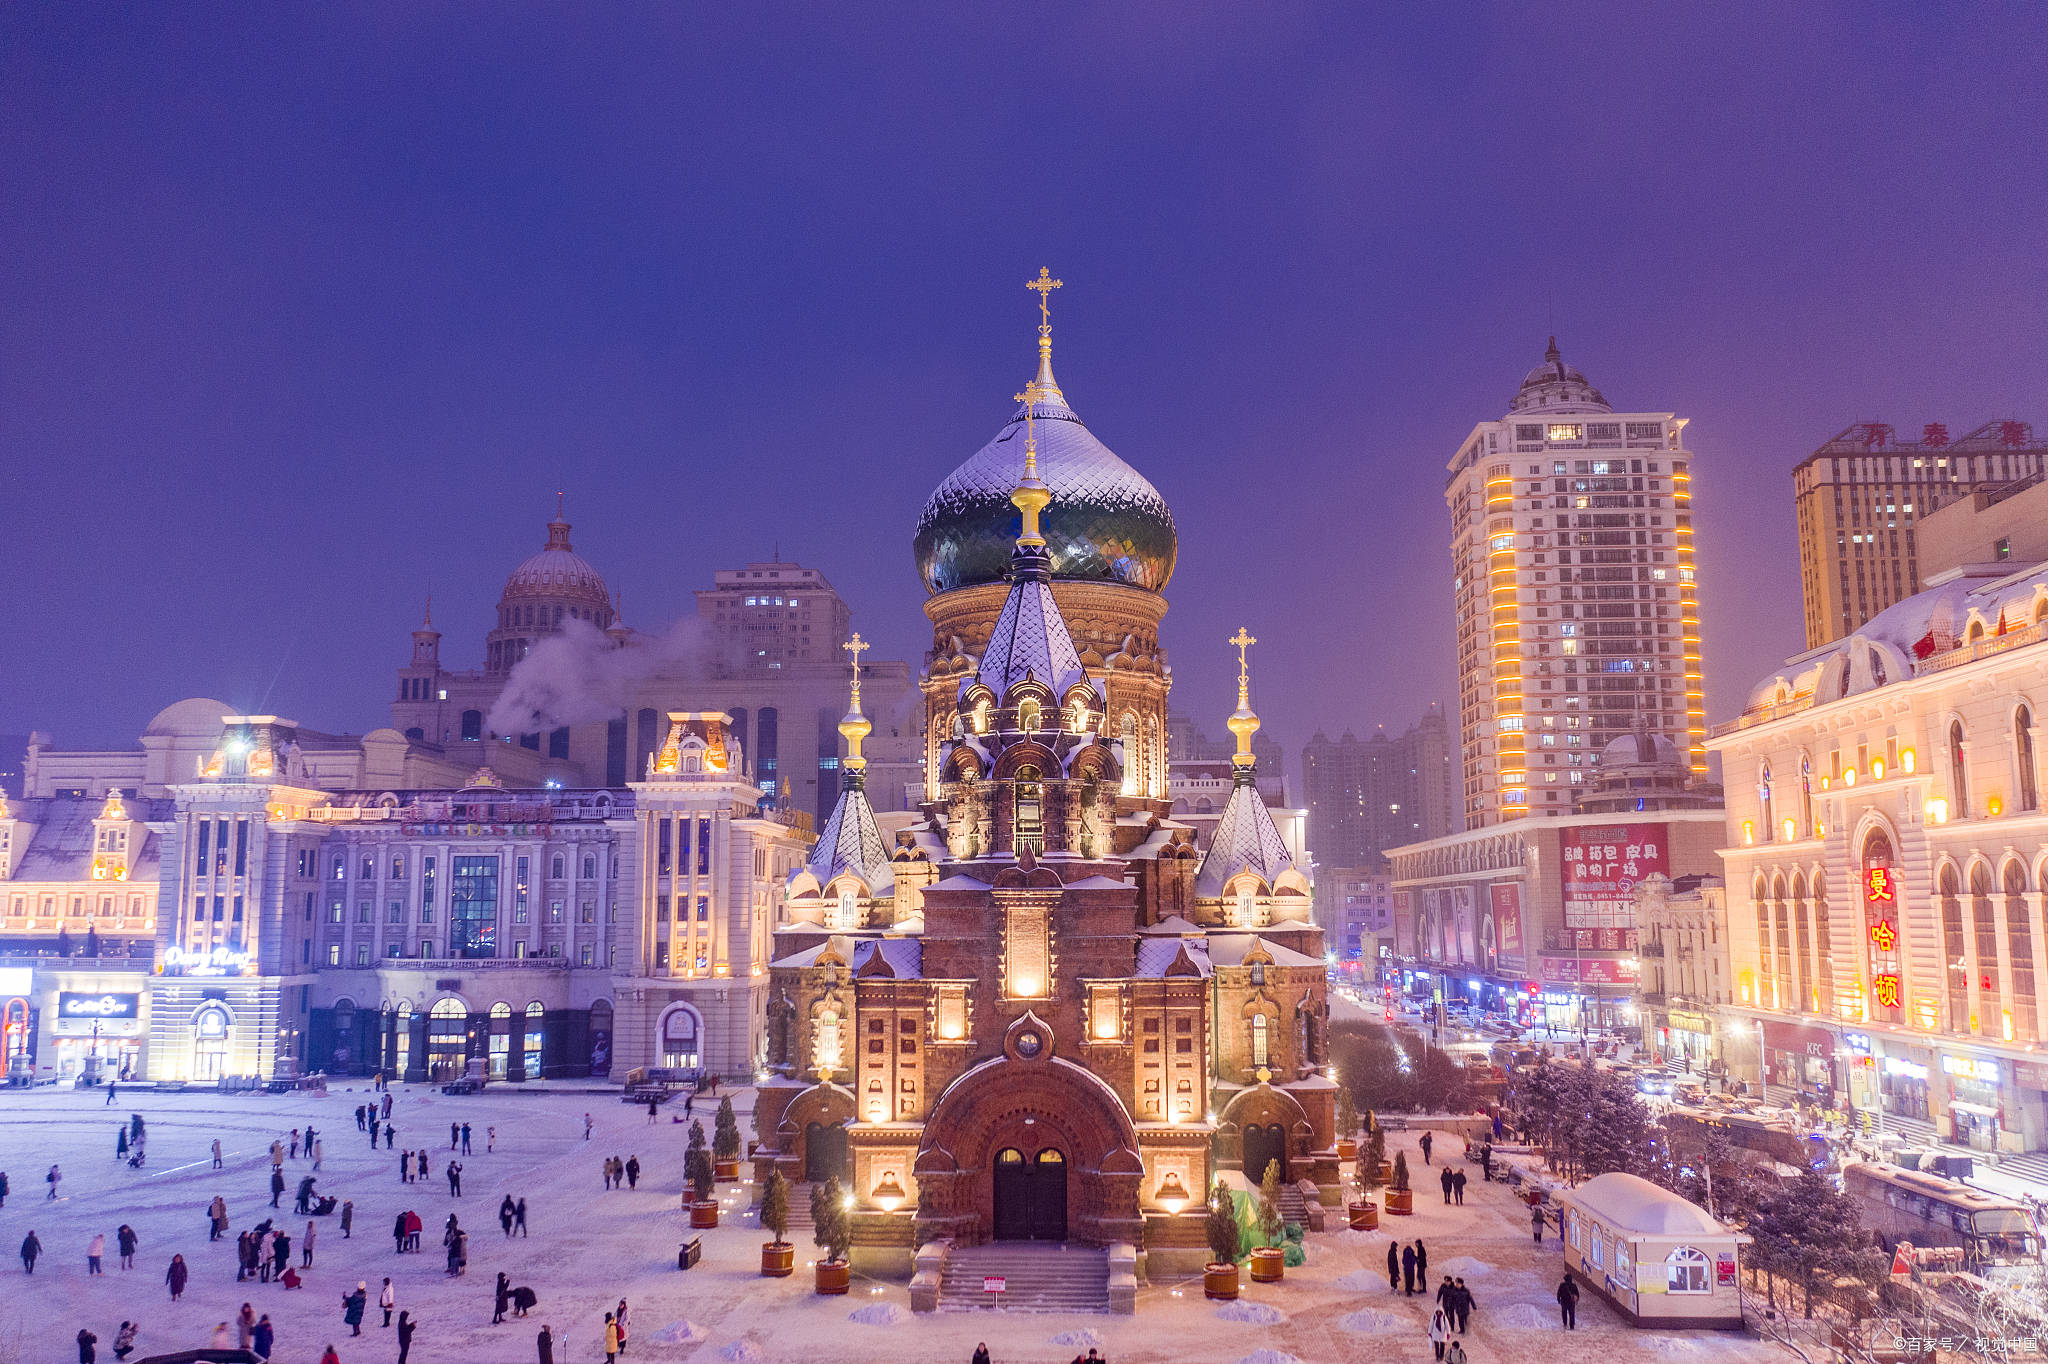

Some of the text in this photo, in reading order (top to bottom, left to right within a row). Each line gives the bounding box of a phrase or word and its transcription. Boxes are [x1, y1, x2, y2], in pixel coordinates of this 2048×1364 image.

[1589, 844, 1617, 860] 箱包
[1626, 844, 1658, 859] 皮具
[1576, 861, 1638, 878] 购物广场
[1869, 868, 1900, 1008] 曼哈顿
[1806, 1042, 1823, 1056] KFC
